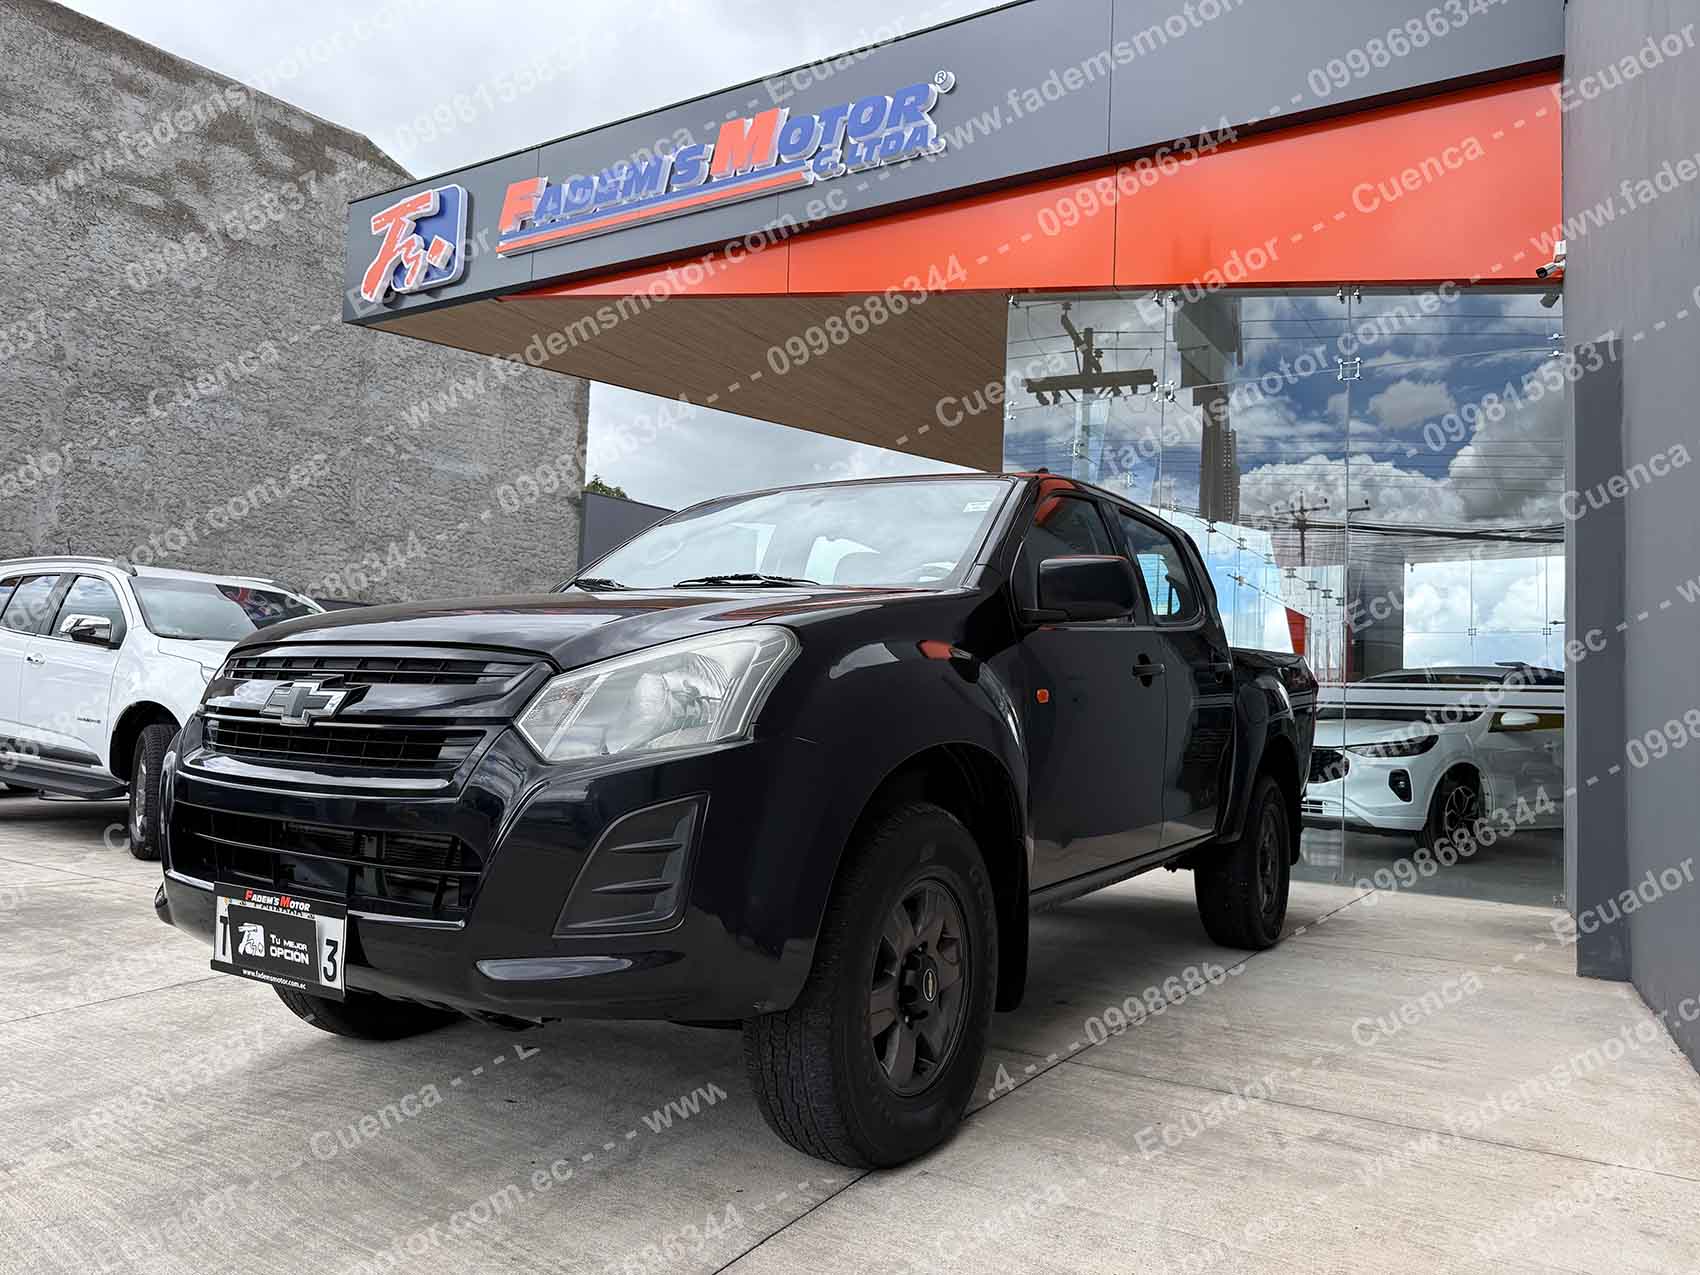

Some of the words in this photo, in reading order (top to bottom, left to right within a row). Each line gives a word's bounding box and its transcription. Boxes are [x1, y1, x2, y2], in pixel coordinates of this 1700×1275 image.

[709, 82, 938, 177] MOTOR
[280, 895, 312, 912] MOTOR
[269, 945, 310, 966] OPCIÓN
[282, 939, 308, 951] MEJOR
[322, 938, 340, 982] 3
